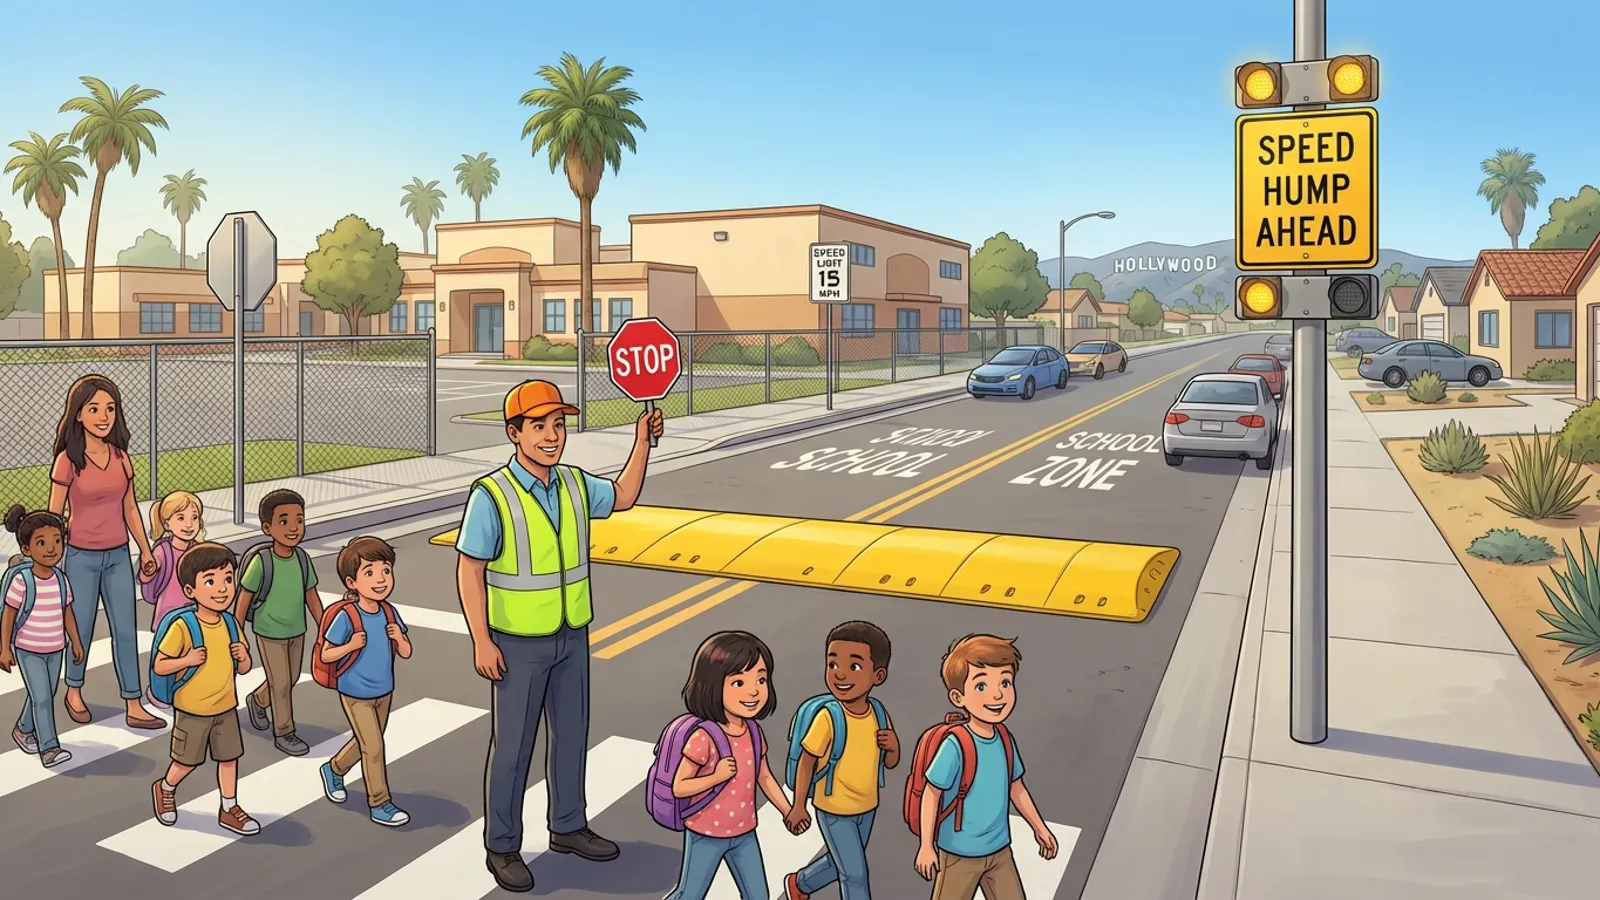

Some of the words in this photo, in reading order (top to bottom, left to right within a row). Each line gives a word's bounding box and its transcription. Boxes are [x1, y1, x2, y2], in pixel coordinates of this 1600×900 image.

[1258, 132, 1355, 166] SPEED
[1264, 173, 1350, 207] HUMP
[1255, 214, 1357, 248] AHEAD
[814, 248, 846, 257] SPEED
[1114, 255, 1218, 273] HOLLYWOOD
[819, 270, 840, 287] 15
[819, 289, 840, 298] MPH
[616, 343, 674, 377] STOP
[1055, 431, 1163, 453] SCHOOL
[769, 447, 949, 478] SCHOOL
[1008, 455, 1140, 491] ZONE
